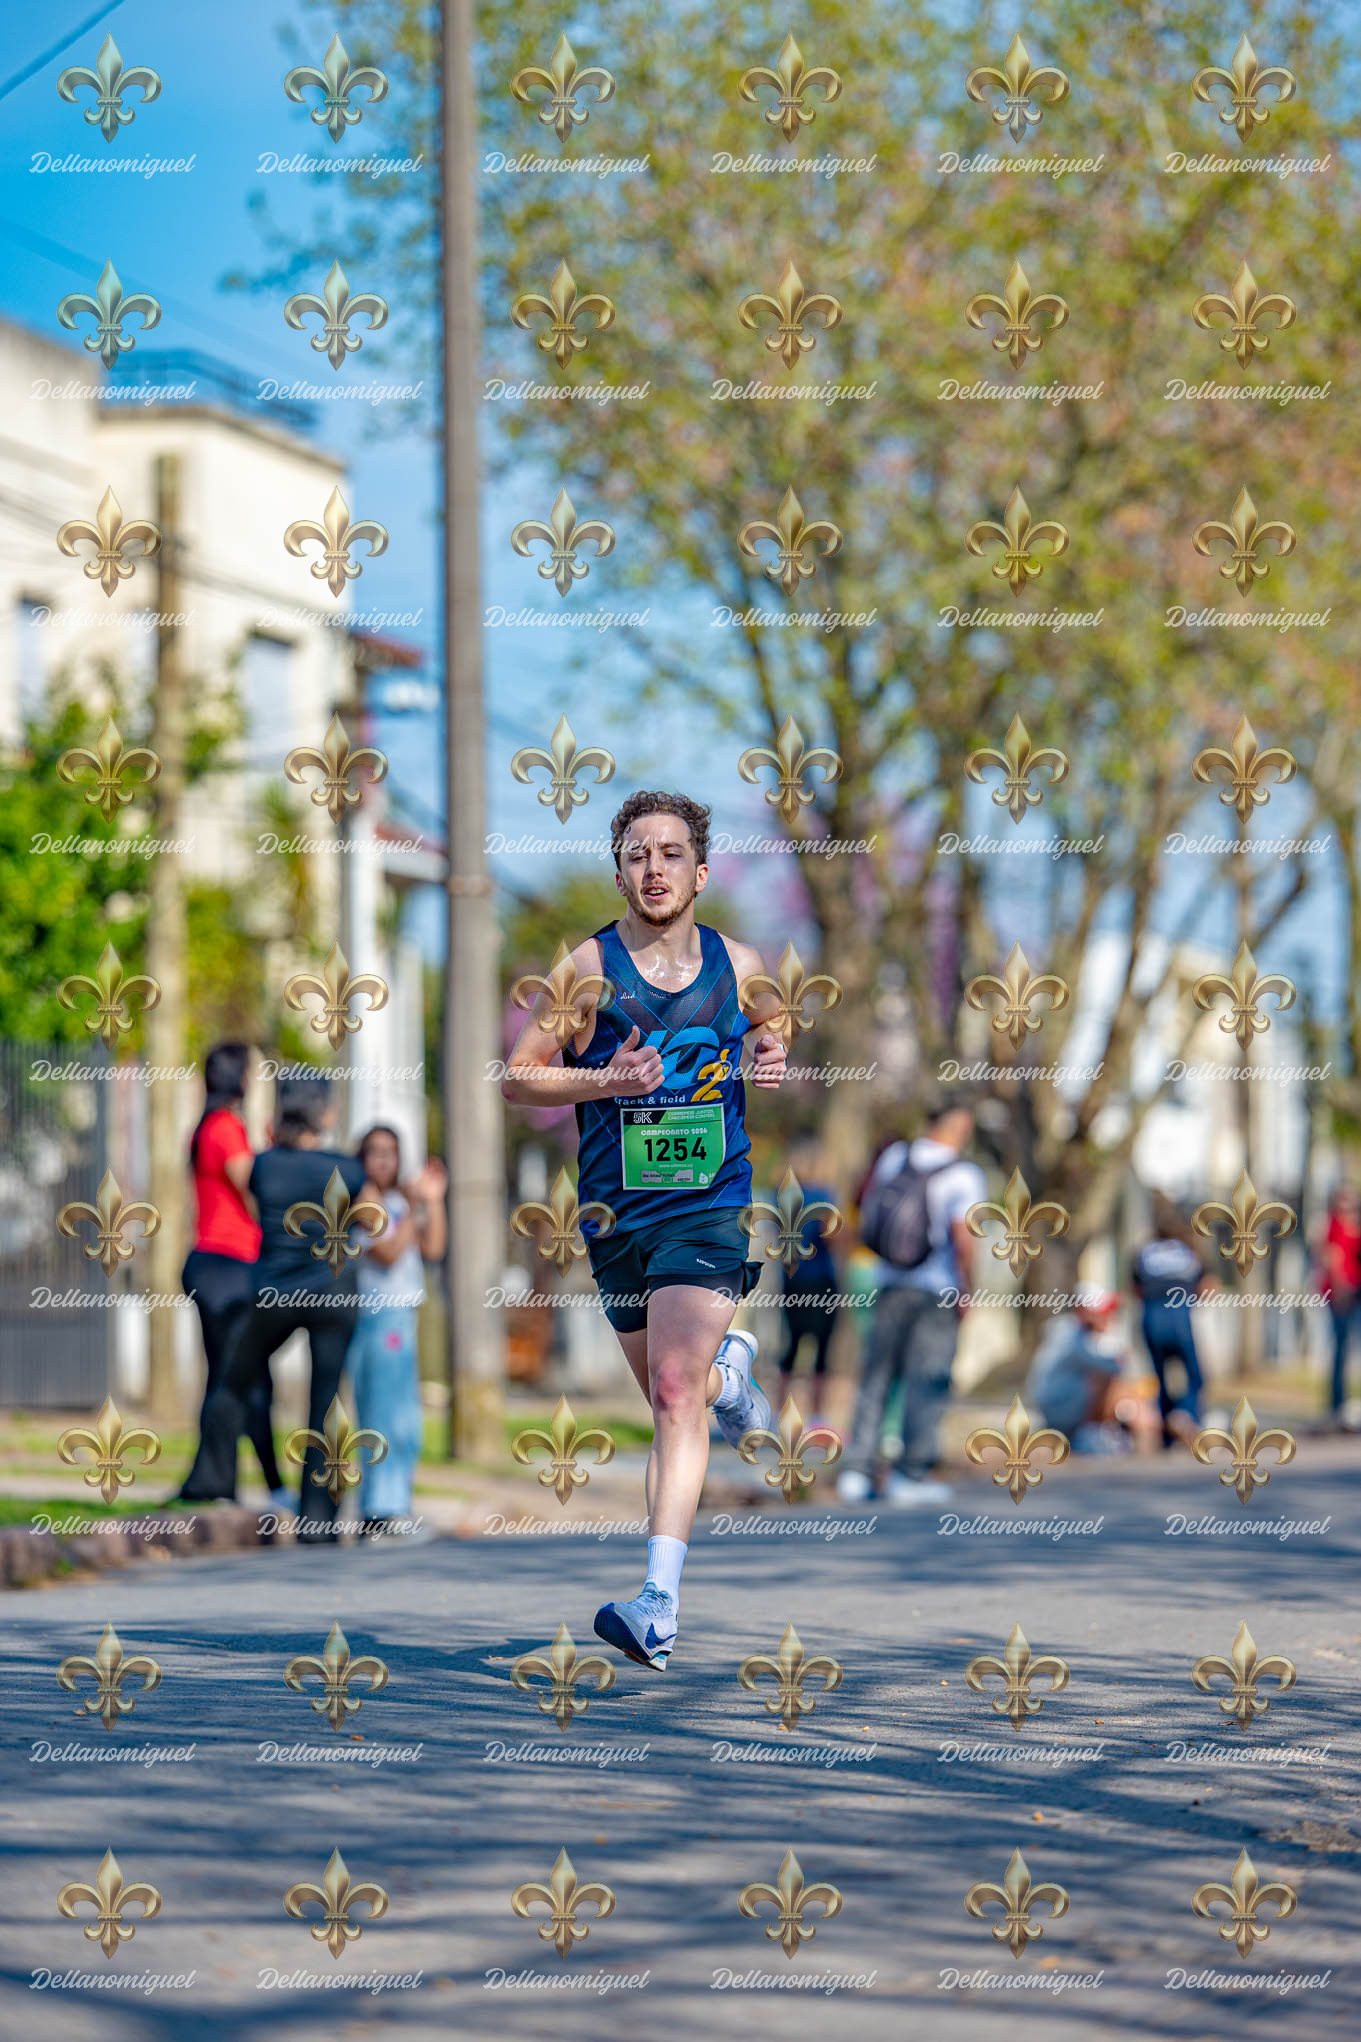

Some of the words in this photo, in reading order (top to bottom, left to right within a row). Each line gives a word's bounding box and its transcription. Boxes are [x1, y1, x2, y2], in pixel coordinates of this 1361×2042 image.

[647, 1096, 656, 1105] &
[660, 1094, 686, 1104] field
[633, 1111, 653, 1124] 5K
[640, 1128, 690, 1136] CAMPEONATO
[644, 1137, 707, 1162] 1254
